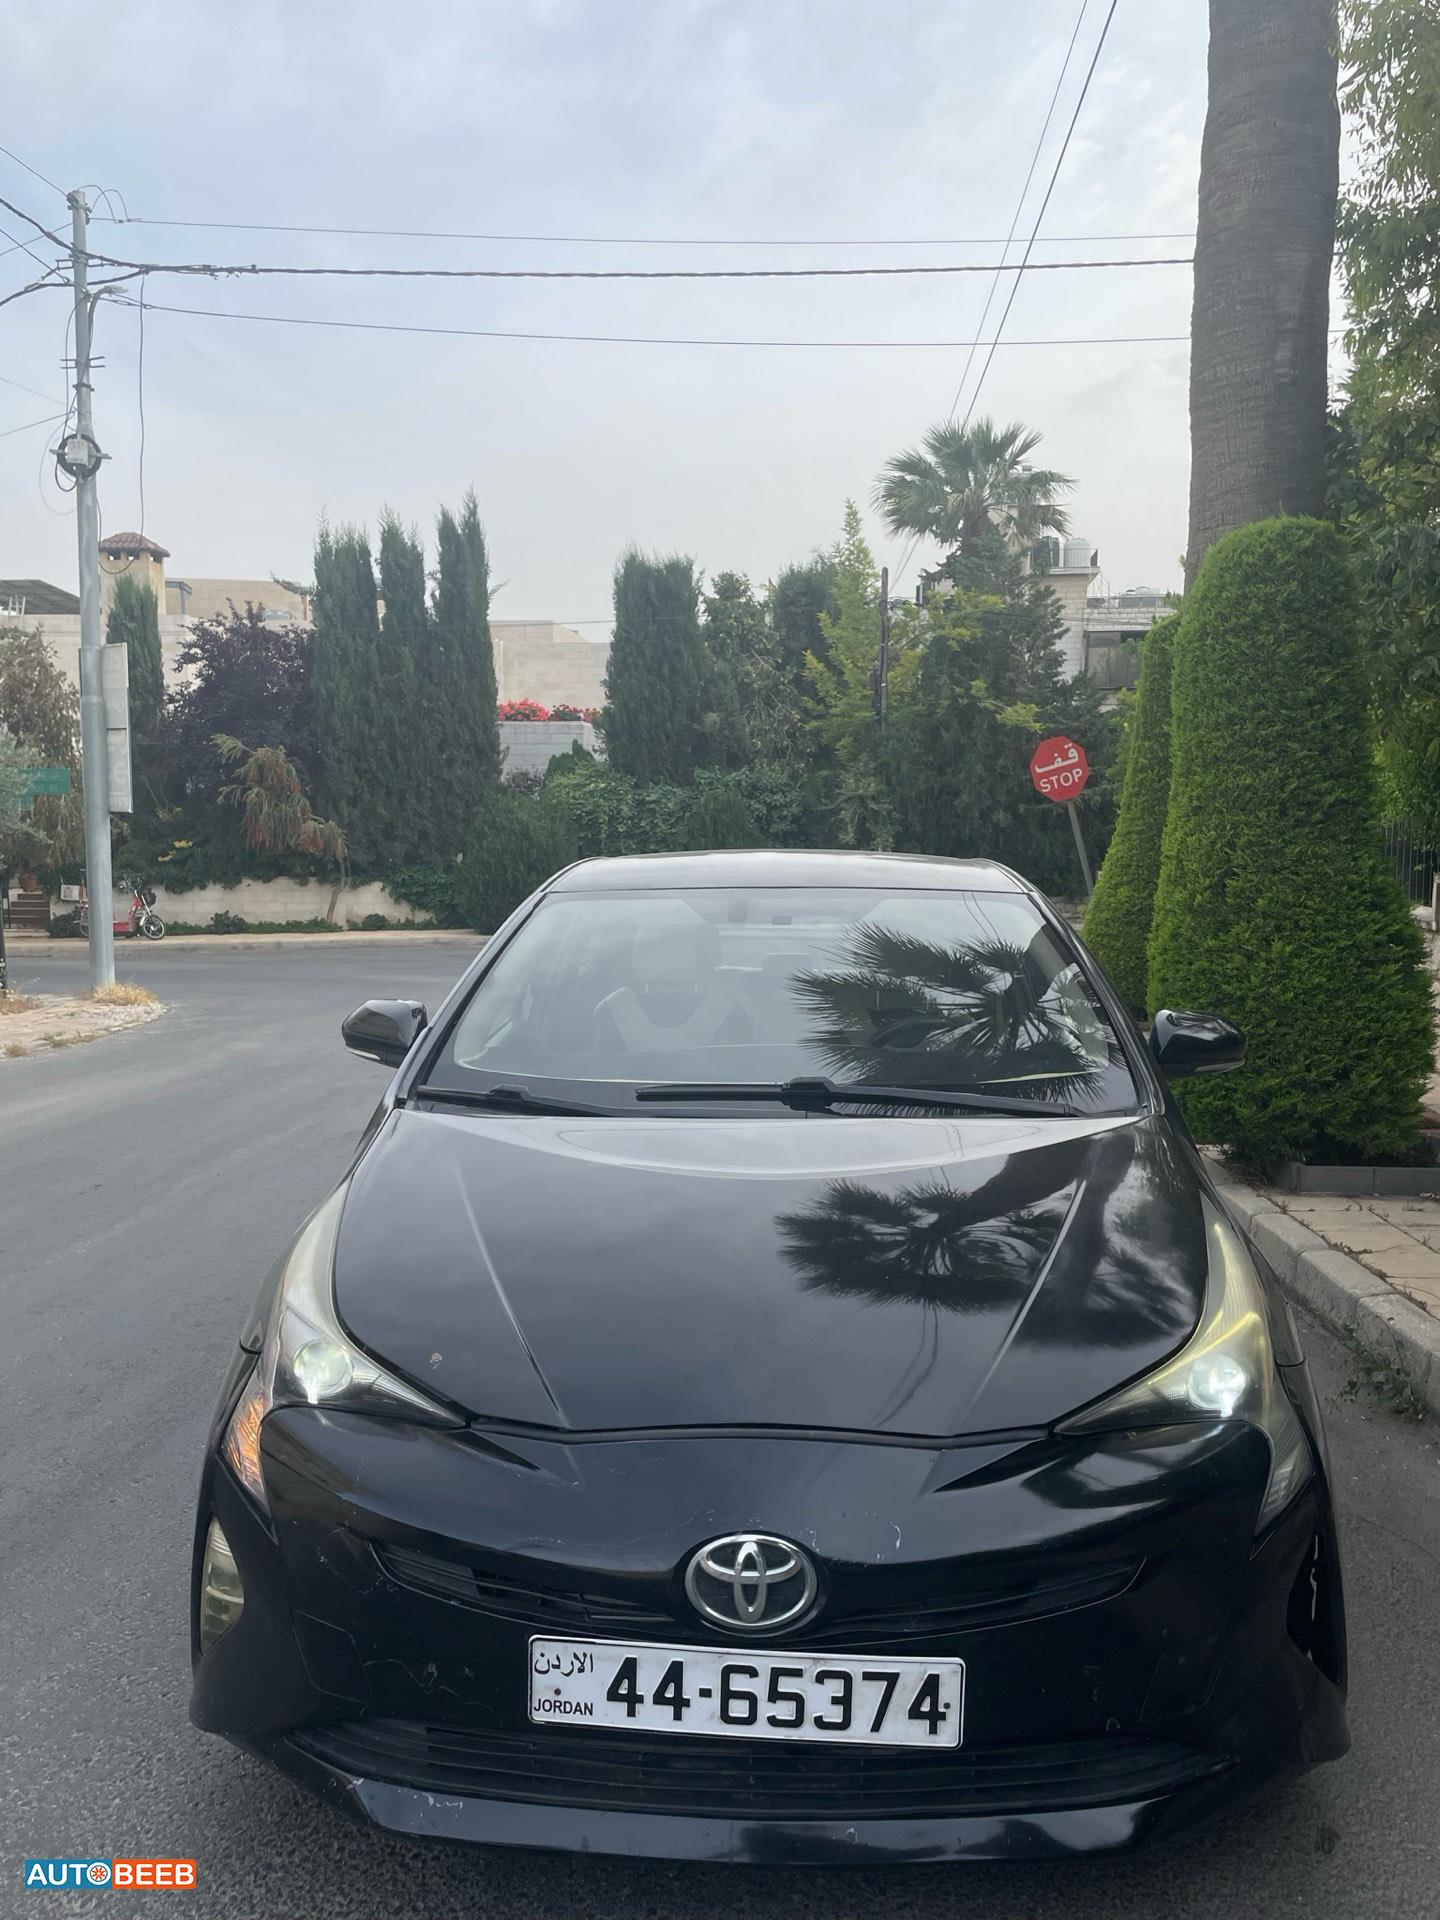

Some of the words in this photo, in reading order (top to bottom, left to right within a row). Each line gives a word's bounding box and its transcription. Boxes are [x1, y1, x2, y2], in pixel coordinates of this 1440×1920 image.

[1035, 743, 1079, 773] قف
[1040, 768, 1082, 792] STOP
[534, 1652, 594, 1677] الاردن
[533, 1698, 594, 1716] JORDAN
[606, 1656, 946, 1735] 44-65374
